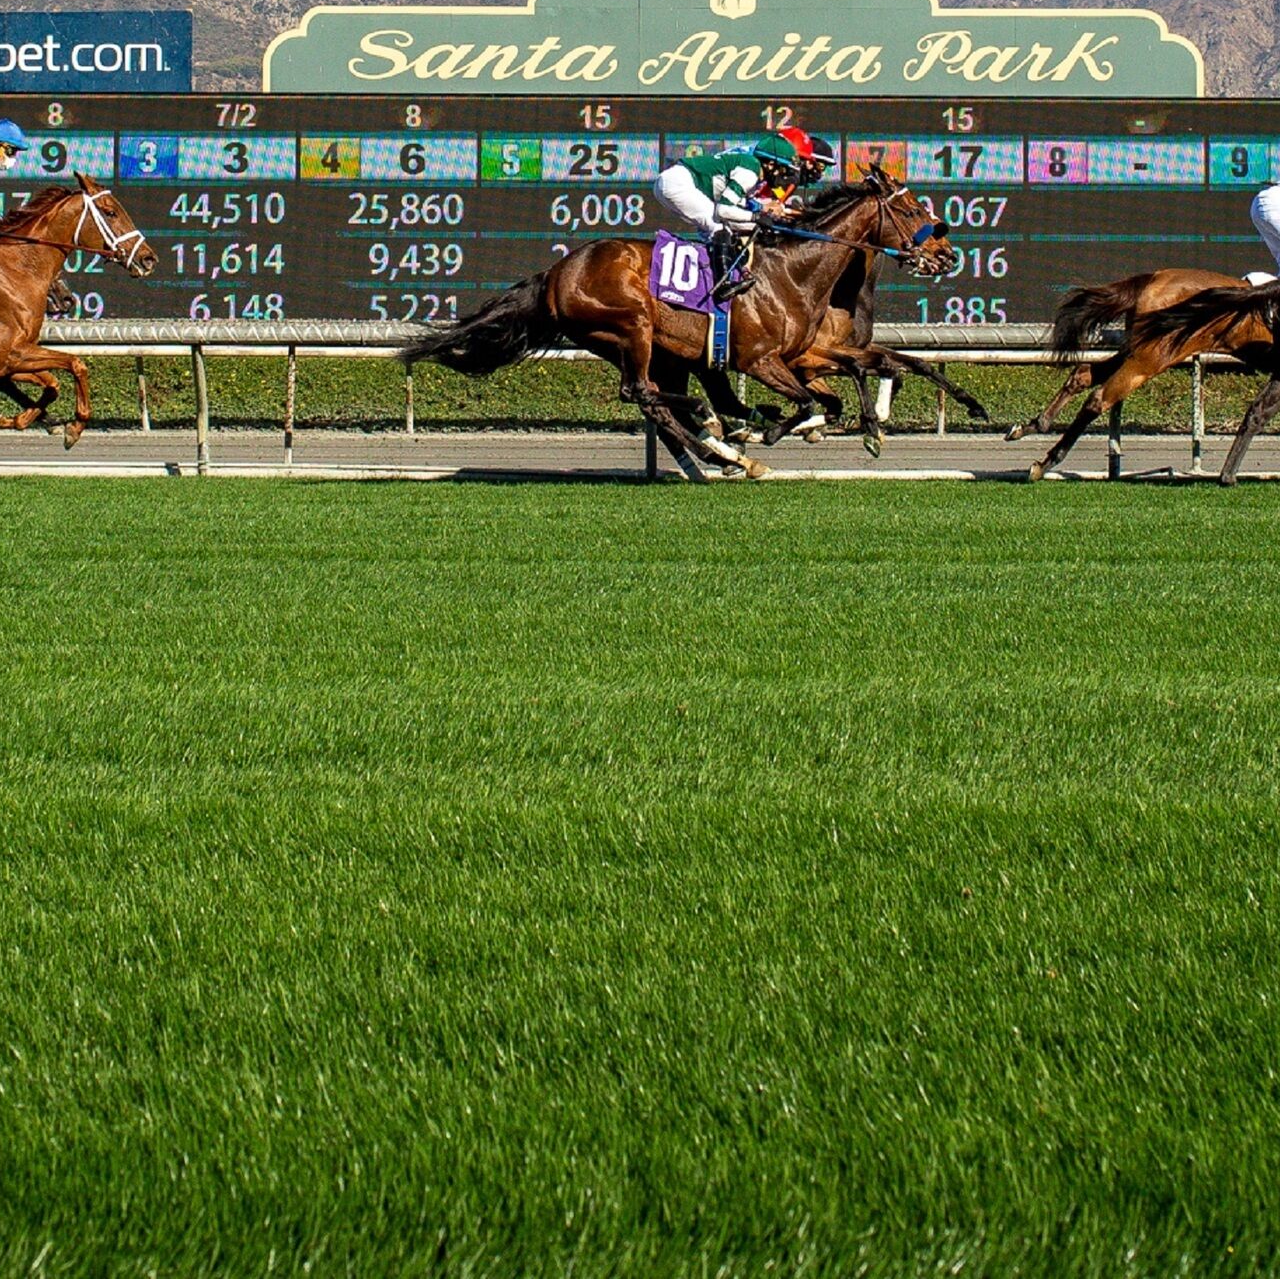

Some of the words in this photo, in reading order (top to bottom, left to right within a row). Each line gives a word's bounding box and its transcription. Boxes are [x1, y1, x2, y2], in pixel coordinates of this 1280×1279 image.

[348, 30, 618, 80] Santa
[637, 31, 883, 91] Anita
[903, 30, 1119, 82] Park
[48, 102, 64, 126] 8
[216, 103, 257, 127] 7/2
[406, 104, 421, 127] 8
[579, 105, 611, 129] 15
[761, 106, 793, 130] 12
[942, 107, 973, 131] 15
[41, 141, 67, 173] 9
[138, 140, 158, 173] 3
[223, 141, 249, 174] 3
[321, 142, 341, 173] 4
[399, 143, 426, 175] 6
[501, 143, 521, 176] 5
[570, 144, 619, 176] 25
[934, 146, 983, 178] 17
[1049, 146, 1068, 177] 8
[1231, 146, 1249, 177] 9
[169, 192, 286, 229] 44,510
[348, 192, 465, 230] 25,860
[551, 194, 645, 231] 6,008
[171, 243, 286, 279] 11,614
[369, 243, 464, 281] 9,439
[659, 241, 699, 291] 10
[189, 293, 285, 321] 6148
[370, 294, 458, 321] 5221
[916, 296, 1007, 325] 1885
